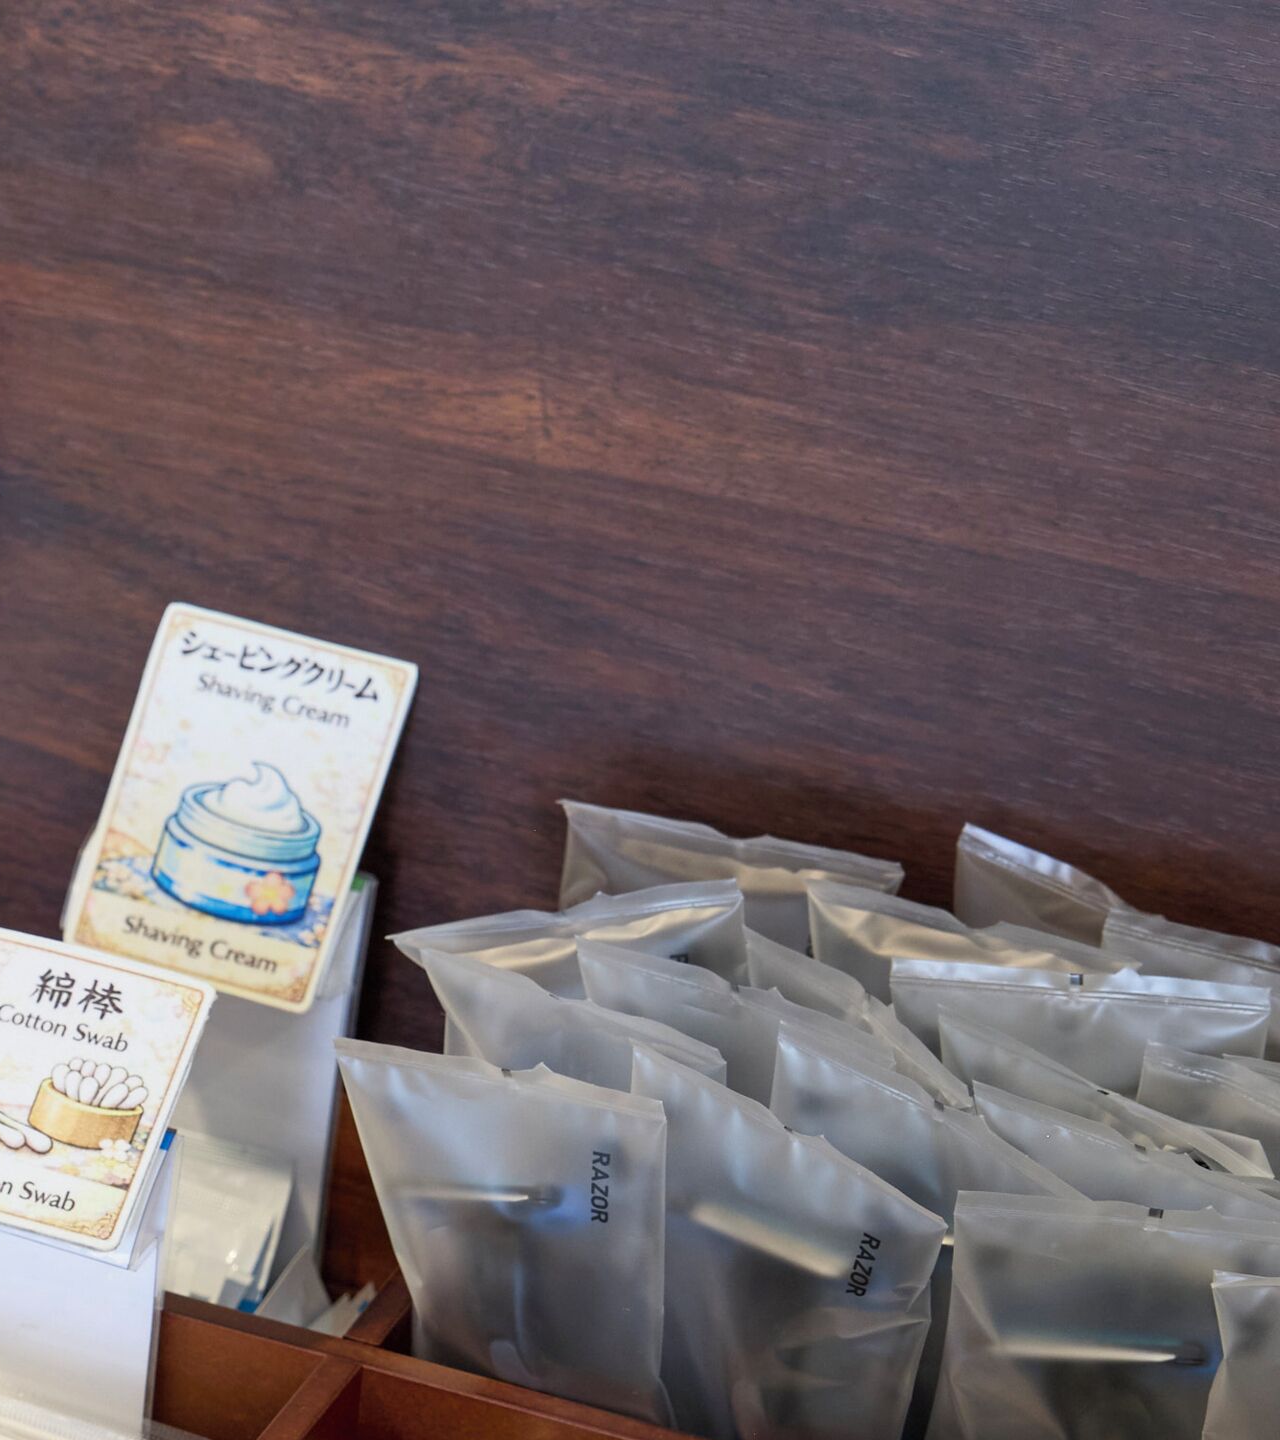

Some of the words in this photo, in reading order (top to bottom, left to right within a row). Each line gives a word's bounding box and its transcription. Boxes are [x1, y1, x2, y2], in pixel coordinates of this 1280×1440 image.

[179, 629, 381, 705] シェービングクリーム
[197, 671, 276, 714] Shaving
[281, 693, 351, 730] Cream
[121, 914, 206, 960] Shaving
[209, 937, 278, 976] Cream
[29, 968, 124, 1021] 綿棒
[72, 1022, 130, 1054] Swab
[20, 1177, 77, 1214] Swab
[588, 1148, 611, 1226] RAZOR
[844, 1231, 882, 1299] RAZOR
